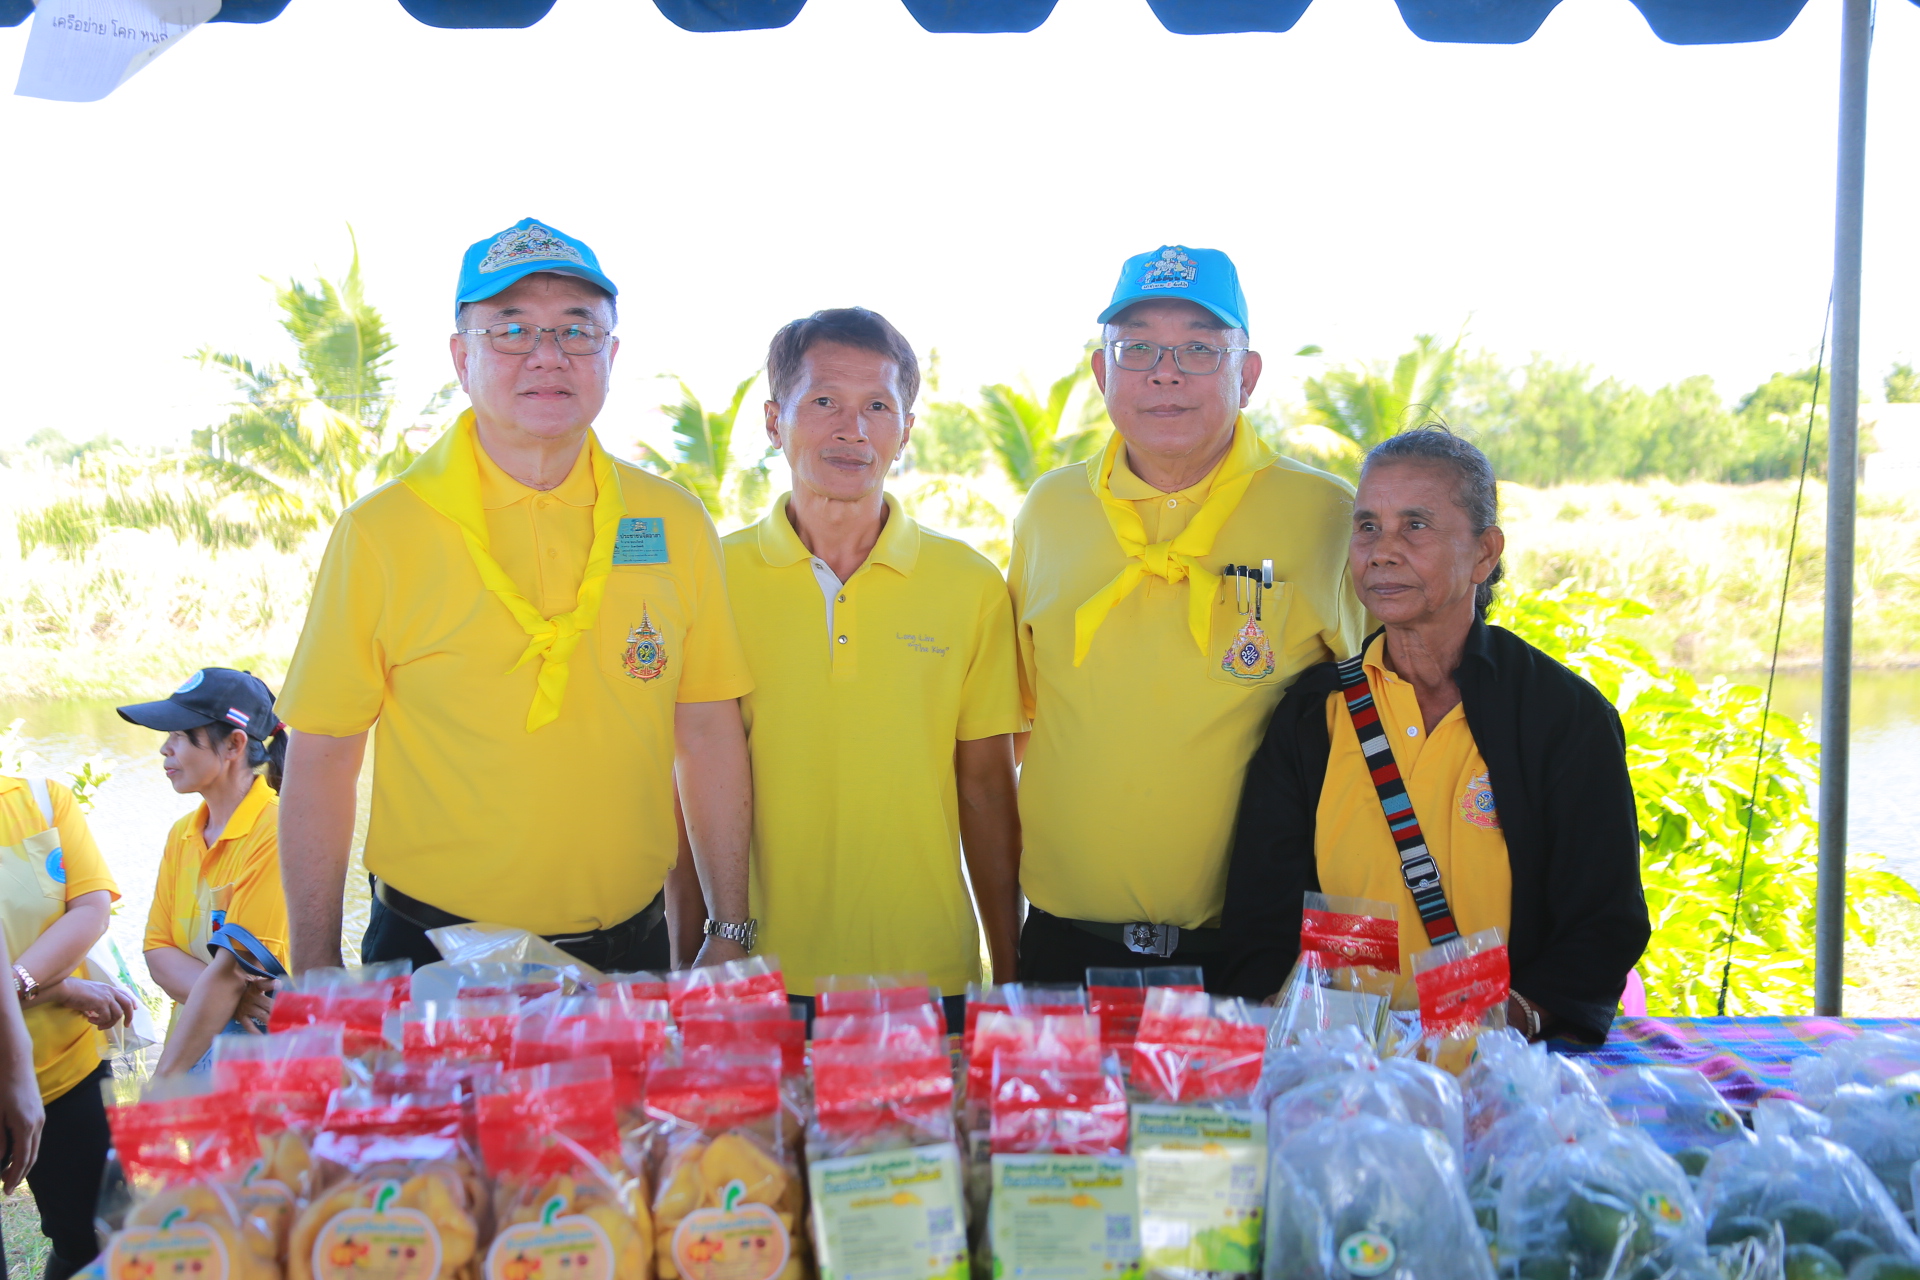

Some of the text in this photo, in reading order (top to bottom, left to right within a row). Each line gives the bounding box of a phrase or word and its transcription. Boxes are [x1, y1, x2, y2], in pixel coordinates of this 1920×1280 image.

[52, 14, 168, 43] เครือข่าย โคก หนอ
[896, 632, 935, 643] Long Live
